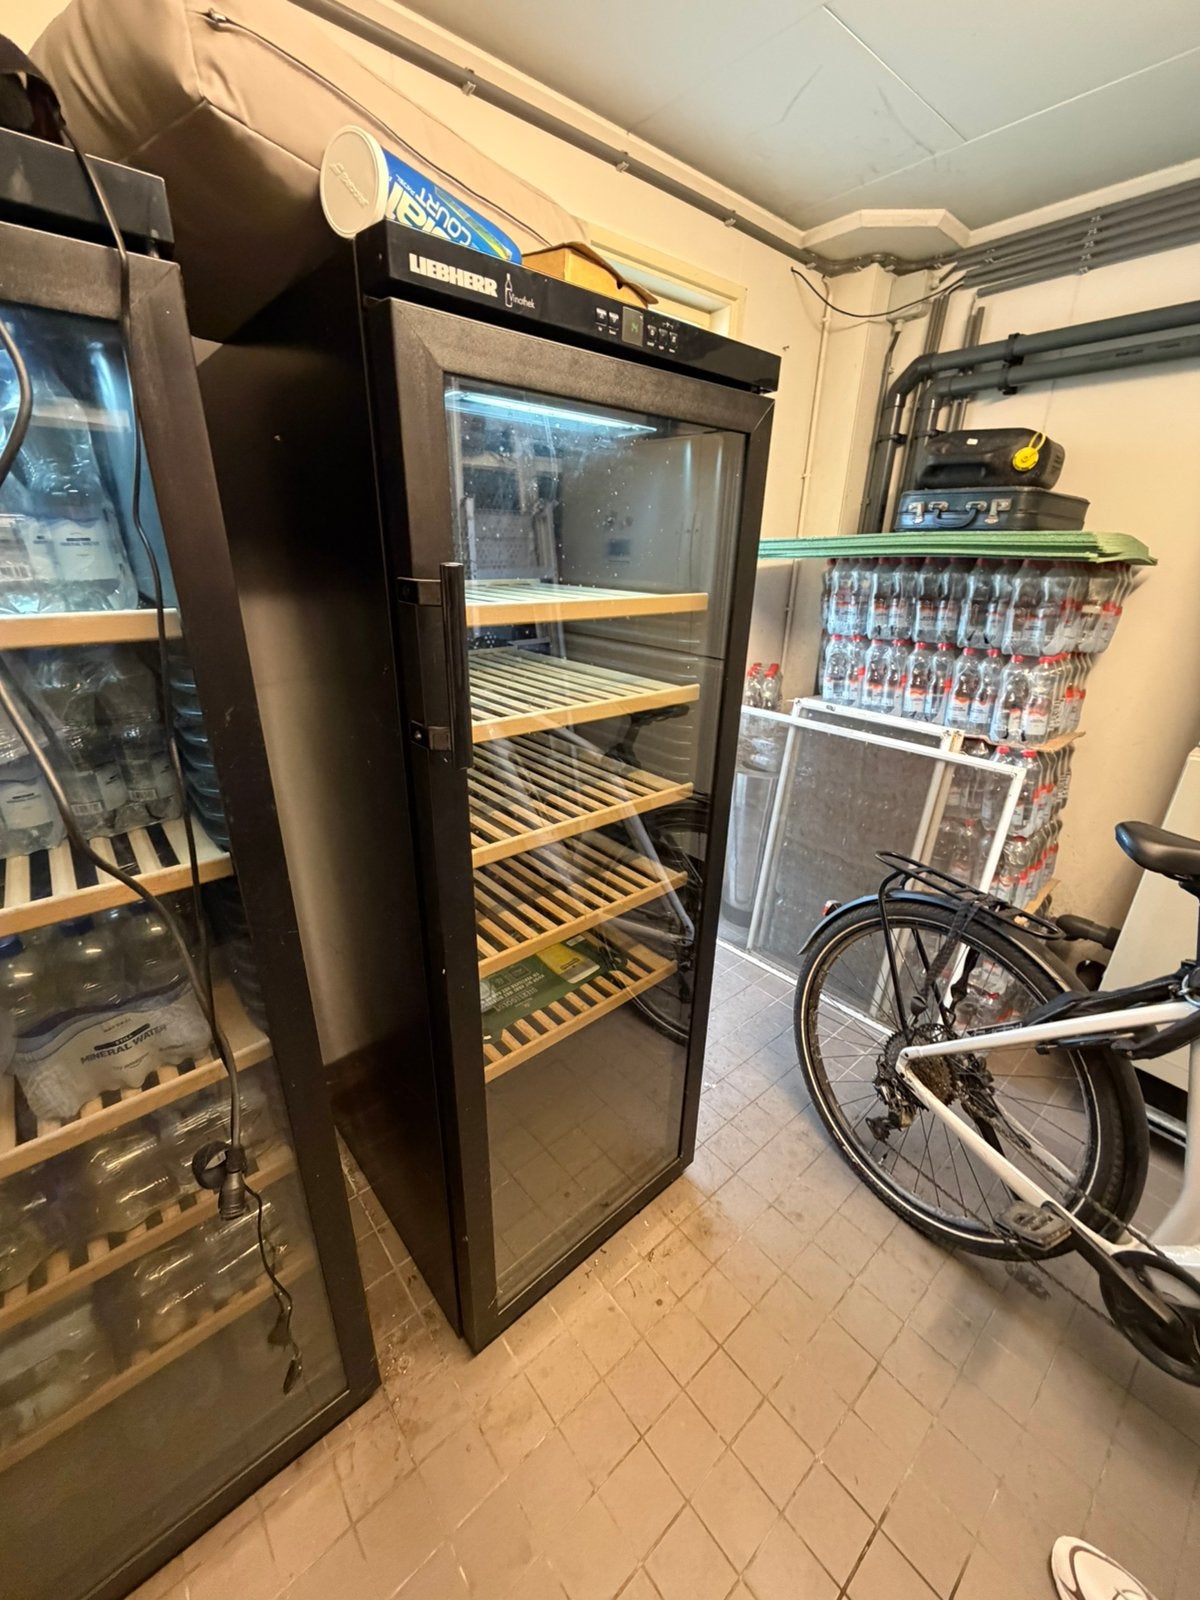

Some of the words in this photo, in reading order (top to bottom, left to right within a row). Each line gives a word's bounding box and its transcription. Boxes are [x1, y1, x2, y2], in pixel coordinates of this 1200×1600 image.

[415, 187, 473, 247] COURT
[408, 252, 499, 299] LIEBHERR
[509, 293, 536, 309] Vinothek
[80, 1043, 133, 1064] MINERAL
[132, 1023, 168, 1046] WATER
